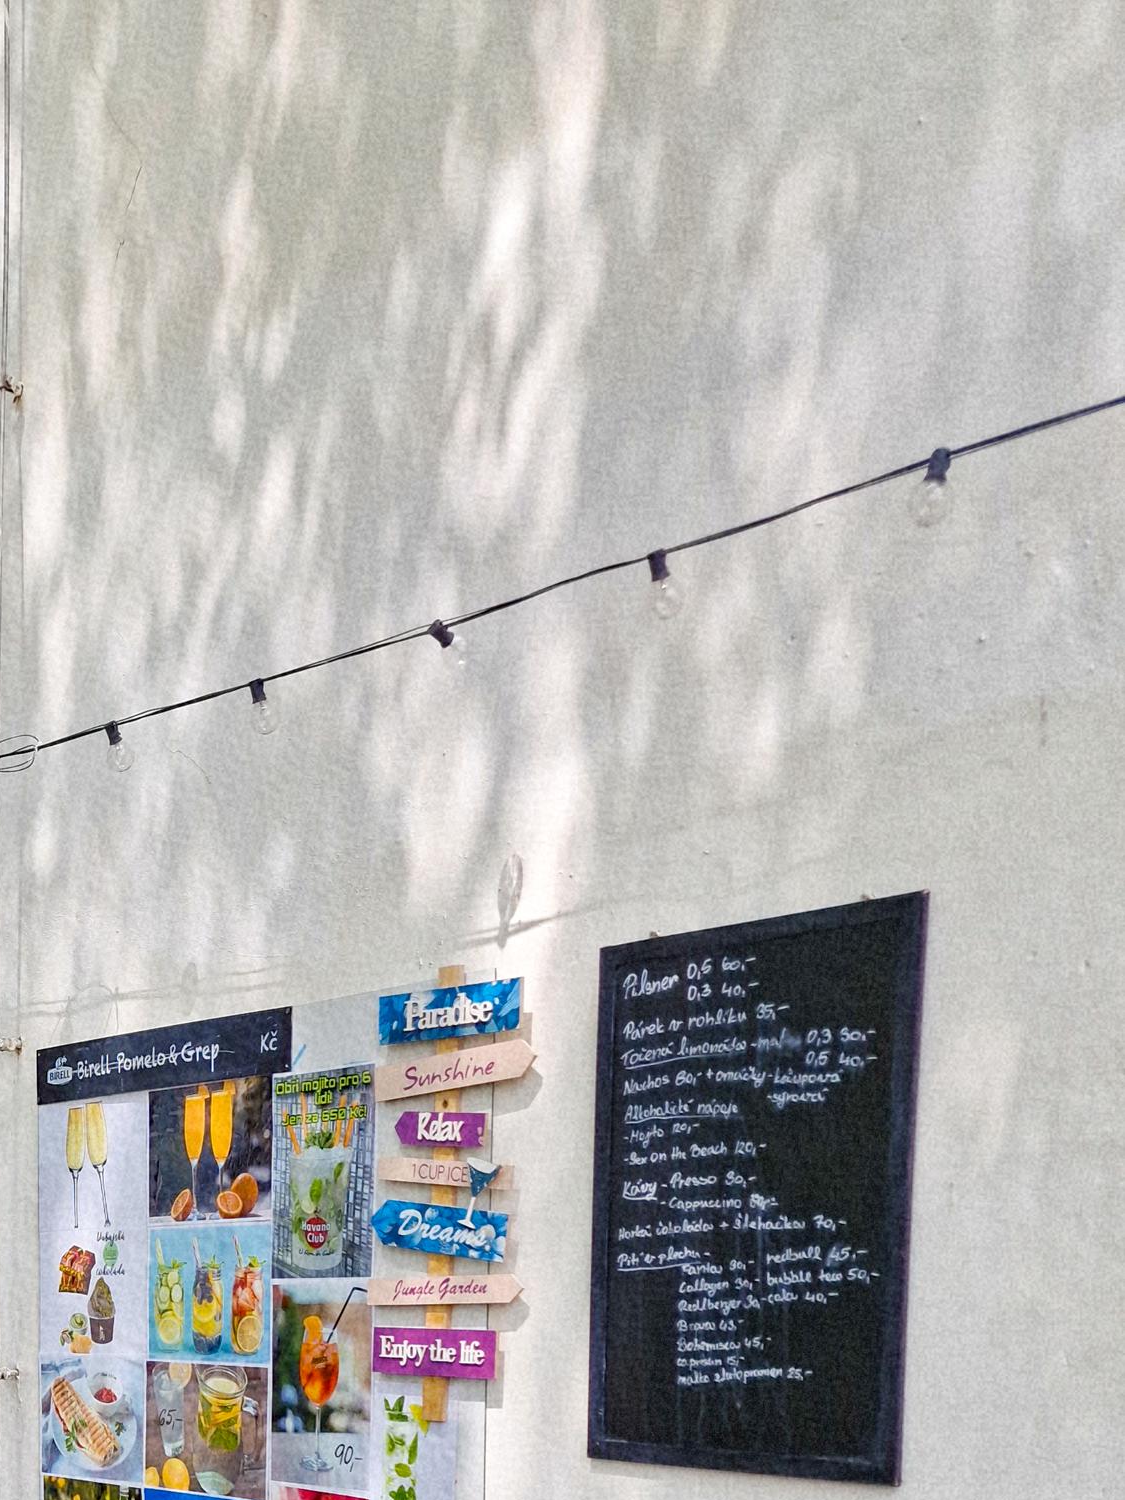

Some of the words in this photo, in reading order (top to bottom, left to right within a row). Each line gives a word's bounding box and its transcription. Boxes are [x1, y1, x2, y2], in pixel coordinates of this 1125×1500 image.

[623, 969, 679, 999] Pilsner
[687, 958, 712, 980] 0,5
[687, 984, 712, 1001] 0,3
[403, 993, 493, 1032] Paradise
[623, 1018, 664, 1040] Párek
[77, 1058, 111, 1080] Birell
[117, 1047, 164, 1078] Pomelo
[181, 1041, 220, 1072] Grep
[260, 1029, 278, 1053] Kč
[620, 1042, 674, 1066] Točená
[301, 1077, 336, 1093] mojito
[339, 1074, 359, 1091] pro
[362, 1071, 371, 1085] 6
[403, 1057, 496, 1091] Sunshine
[623, 1073, 670, 1096] Nachos
[321, 1108, 346, 1121] 650
[417, 1113, 465, 1142] Relax
[650, 1152, 667, 1163] on
[671, 1146, 687, 1160] the
[302, 1221, 331, 1232] Havana
[307, 1233, 324, 1243] Club
[393, 1280, 434, 1301] Jungle
[438, 1278, 488, 1301] Garden
[379, 1335, 429, 1367] Enjoy
[429, 1339, 456, 1363] the
[459, 1340, 485, 1365] life
[158, 1409, 183, 1426] 65,-
[334, 1444, 363, 1473] 90,-
